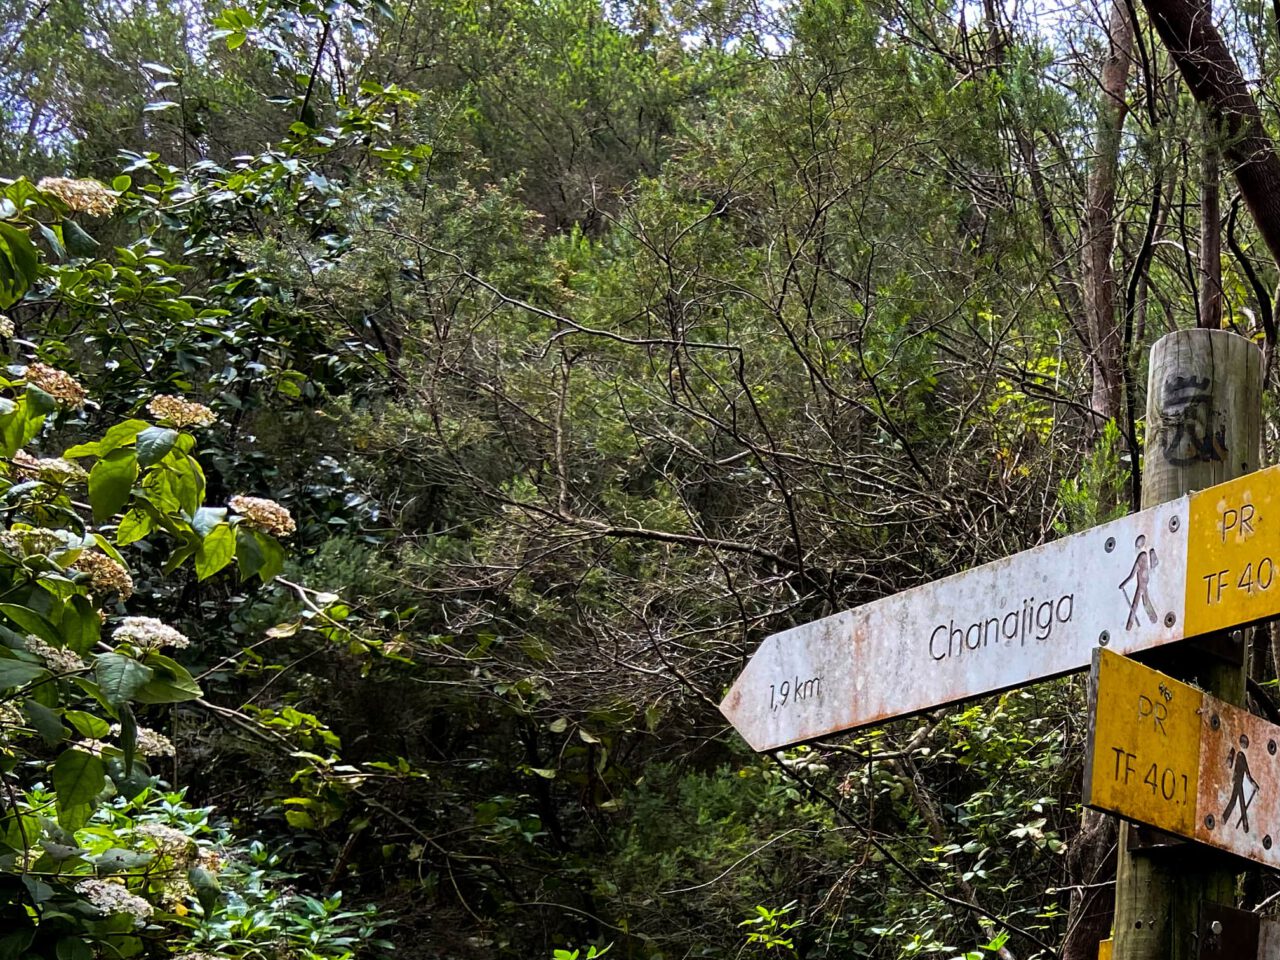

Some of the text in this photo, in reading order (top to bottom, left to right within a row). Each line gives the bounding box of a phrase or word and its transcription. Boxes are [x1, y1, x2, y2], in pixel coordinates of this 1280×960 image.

[1220, 503, 1256, 542] PR
[1202, 556, 1274, 606] TF 40
[928, 592, 1075, 662] Chanajiga
[1137, 694, 1169, 737] PR
[1111, 747, 1135, 786] TF
